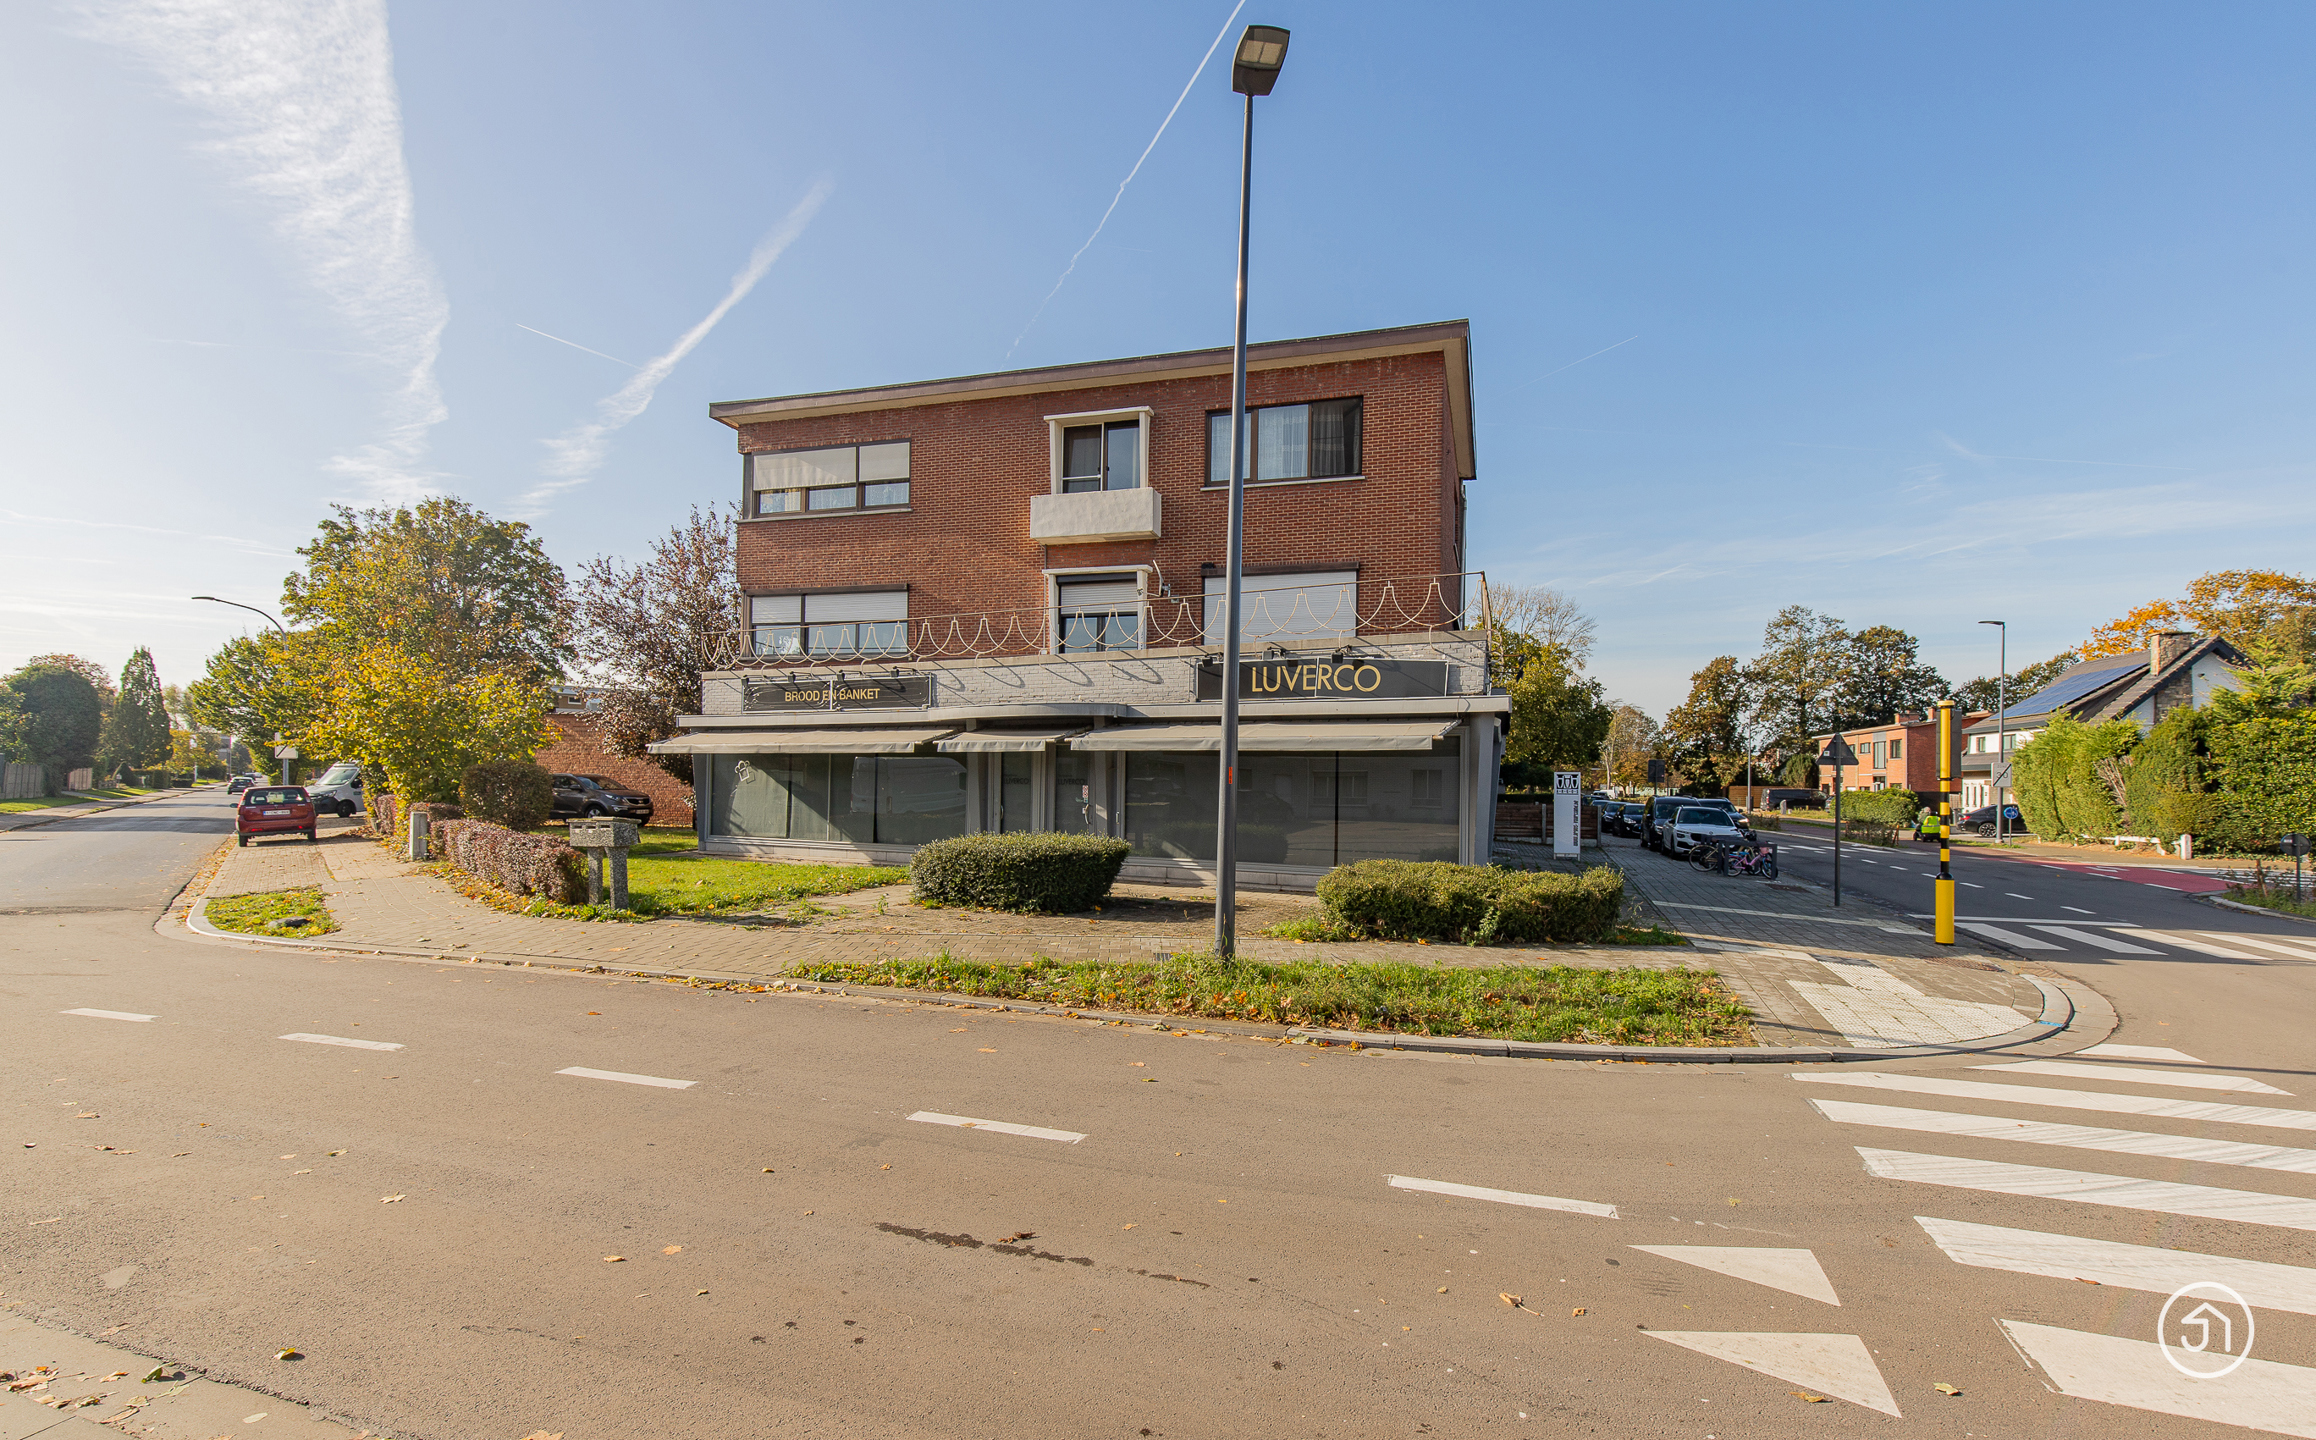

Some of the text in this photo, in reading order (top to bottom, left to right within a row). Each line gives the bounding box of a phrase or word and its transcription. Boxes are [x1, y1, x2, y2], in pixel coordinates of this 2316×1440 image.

[1252, 664, 1381, 692] LUVERCO
[785, 688, 880, 702] BROOD EN BANKET
[1996, 771, 2008, 779] 30
